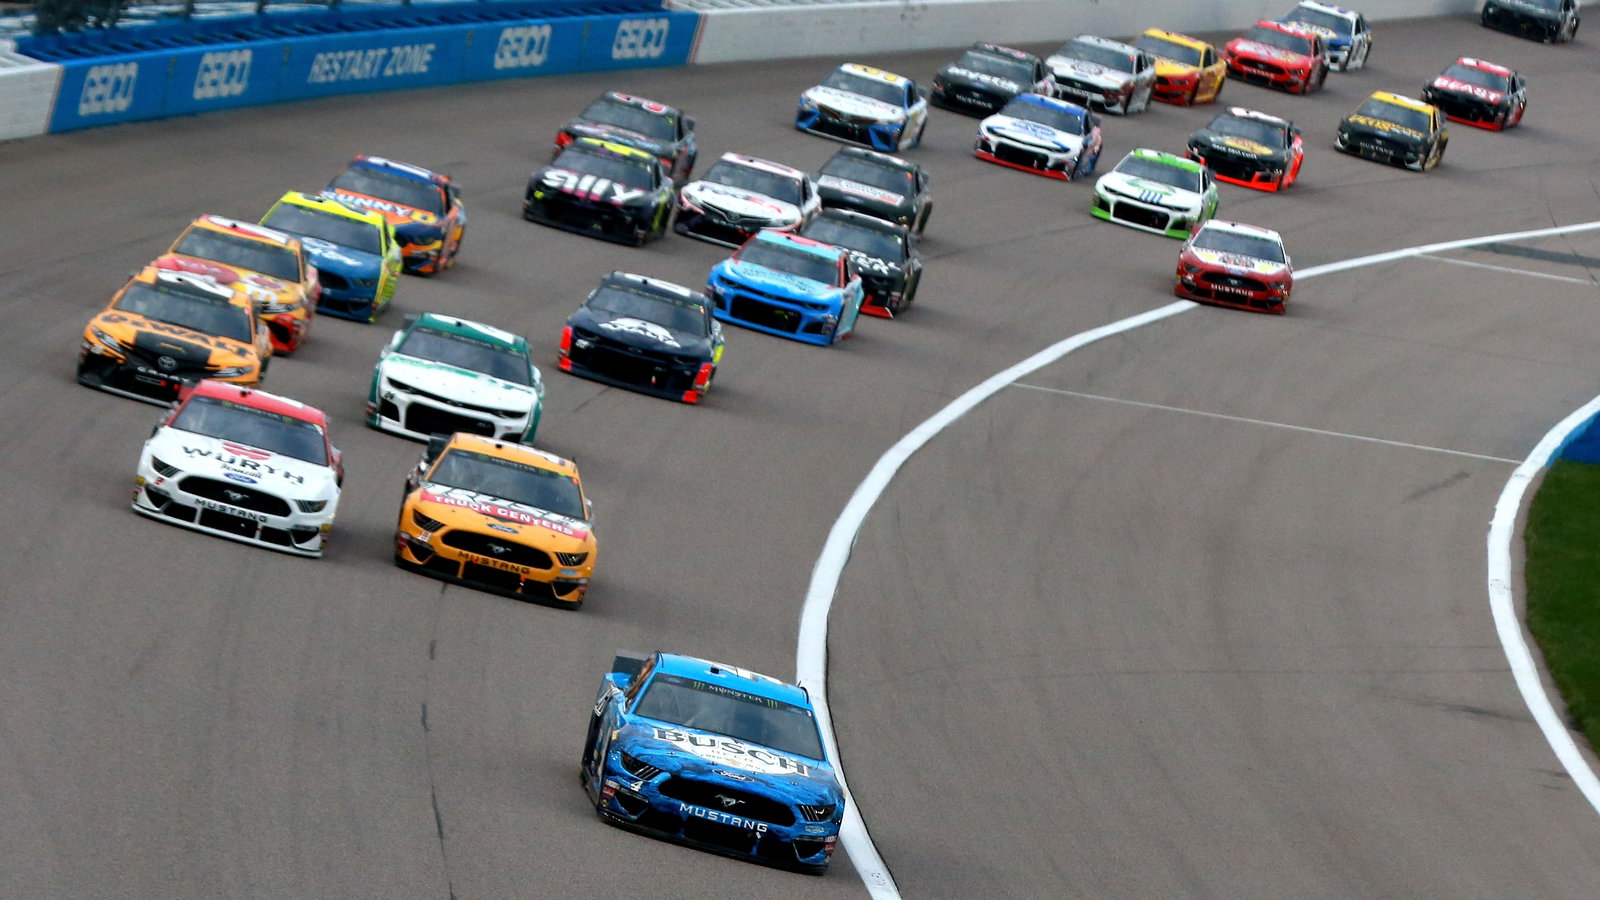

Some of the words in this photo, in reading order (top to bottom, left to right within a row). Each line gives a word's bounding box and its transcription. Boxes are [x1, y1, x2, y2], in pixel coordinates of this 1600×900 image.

[494, 24, 552, 70] GEICO
[611, 18, 669, 60] GEICO
[193, 49, 252, 100] GEICO
[307, 46, 388, 83] RESTART
[383, 43, 435, 76] ZONE
[78, 62, 138, 115] GEICO
[541, 168, 646, 206] ally
[1211, 284, 1254, 297] MUSTANG
[194, 498, 268, 523] MUSTANG
[434, 496, 492, 513] TRUCK
[497, 508, 574, 535] CENTERS
[457, 551, 531, 575] MUSTANG
[708, 685, 763, 703] MONSTER
[652, 728, 810, 778] BUSCH
[630, 780, 644, 792] 4
[679, 803, 768, 834] MUSTANG
